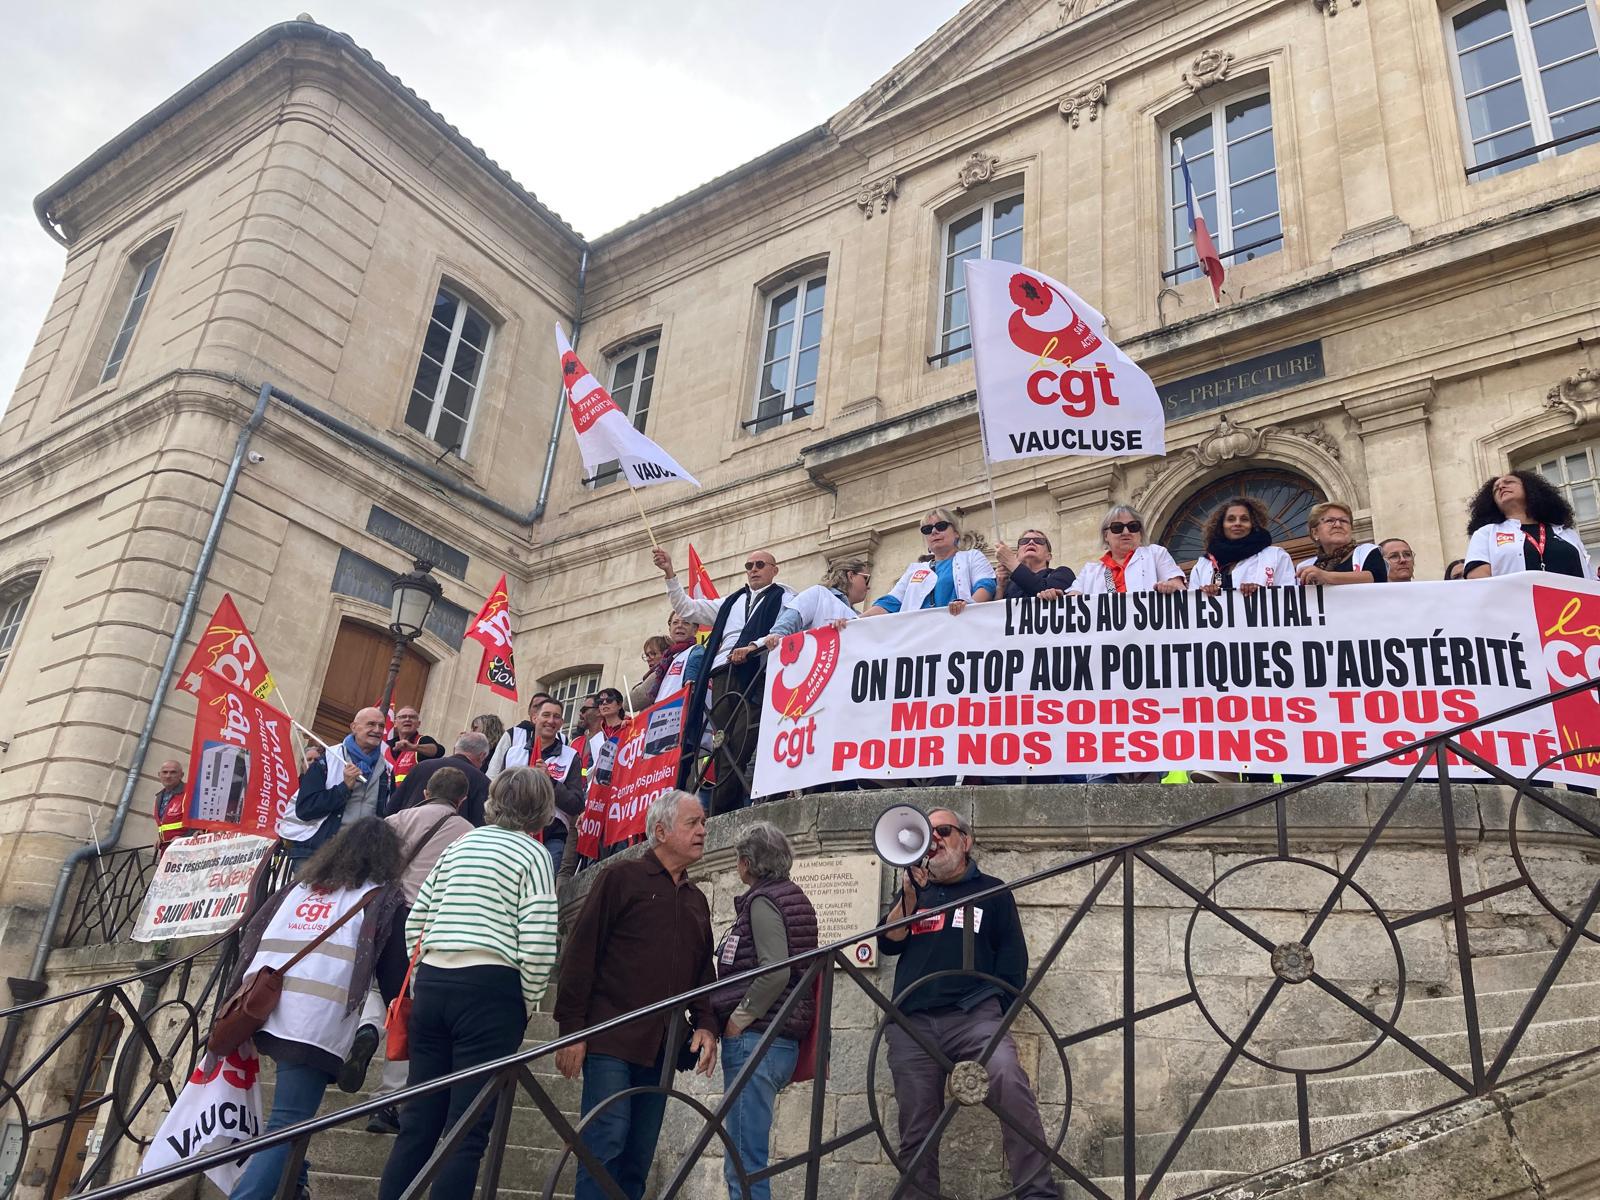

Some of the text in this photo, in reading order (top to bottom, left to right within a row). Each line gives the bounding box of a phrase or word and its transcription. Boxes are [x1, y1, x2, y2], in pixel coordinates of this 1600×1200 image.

[1026, 362, 1120, 418] cgt
[1009, 429, 1142, 454] VAUCLUSE
[1097, 592, 1127, 632] AU
[1242, 586, 1312, 627] VITAL
[851, 628, 1532, 704] ON DIT STOP AUX POLITIQUES D'AUSTÉRITÉ
[777, 687, 825, 726] la
[805, 676, 825, 703] ACTION
[891, 689, 1480, 732] Mobilisons-nous TOUS
[617, 728, 647, 770] cgt
[773, 715, 817, 768] cgt
[832, 729, 1564, 771] POUR NOS BESOINS DE SANTÉ
[164, 861, 183, 873] Des
[820, 873, 854, 881] GAFFAREL
[153, 899, 206, 925] SAUVONS
[288, 922, 327, 932] VAUCLUSE
[295, 902, 332, 922] cgt
